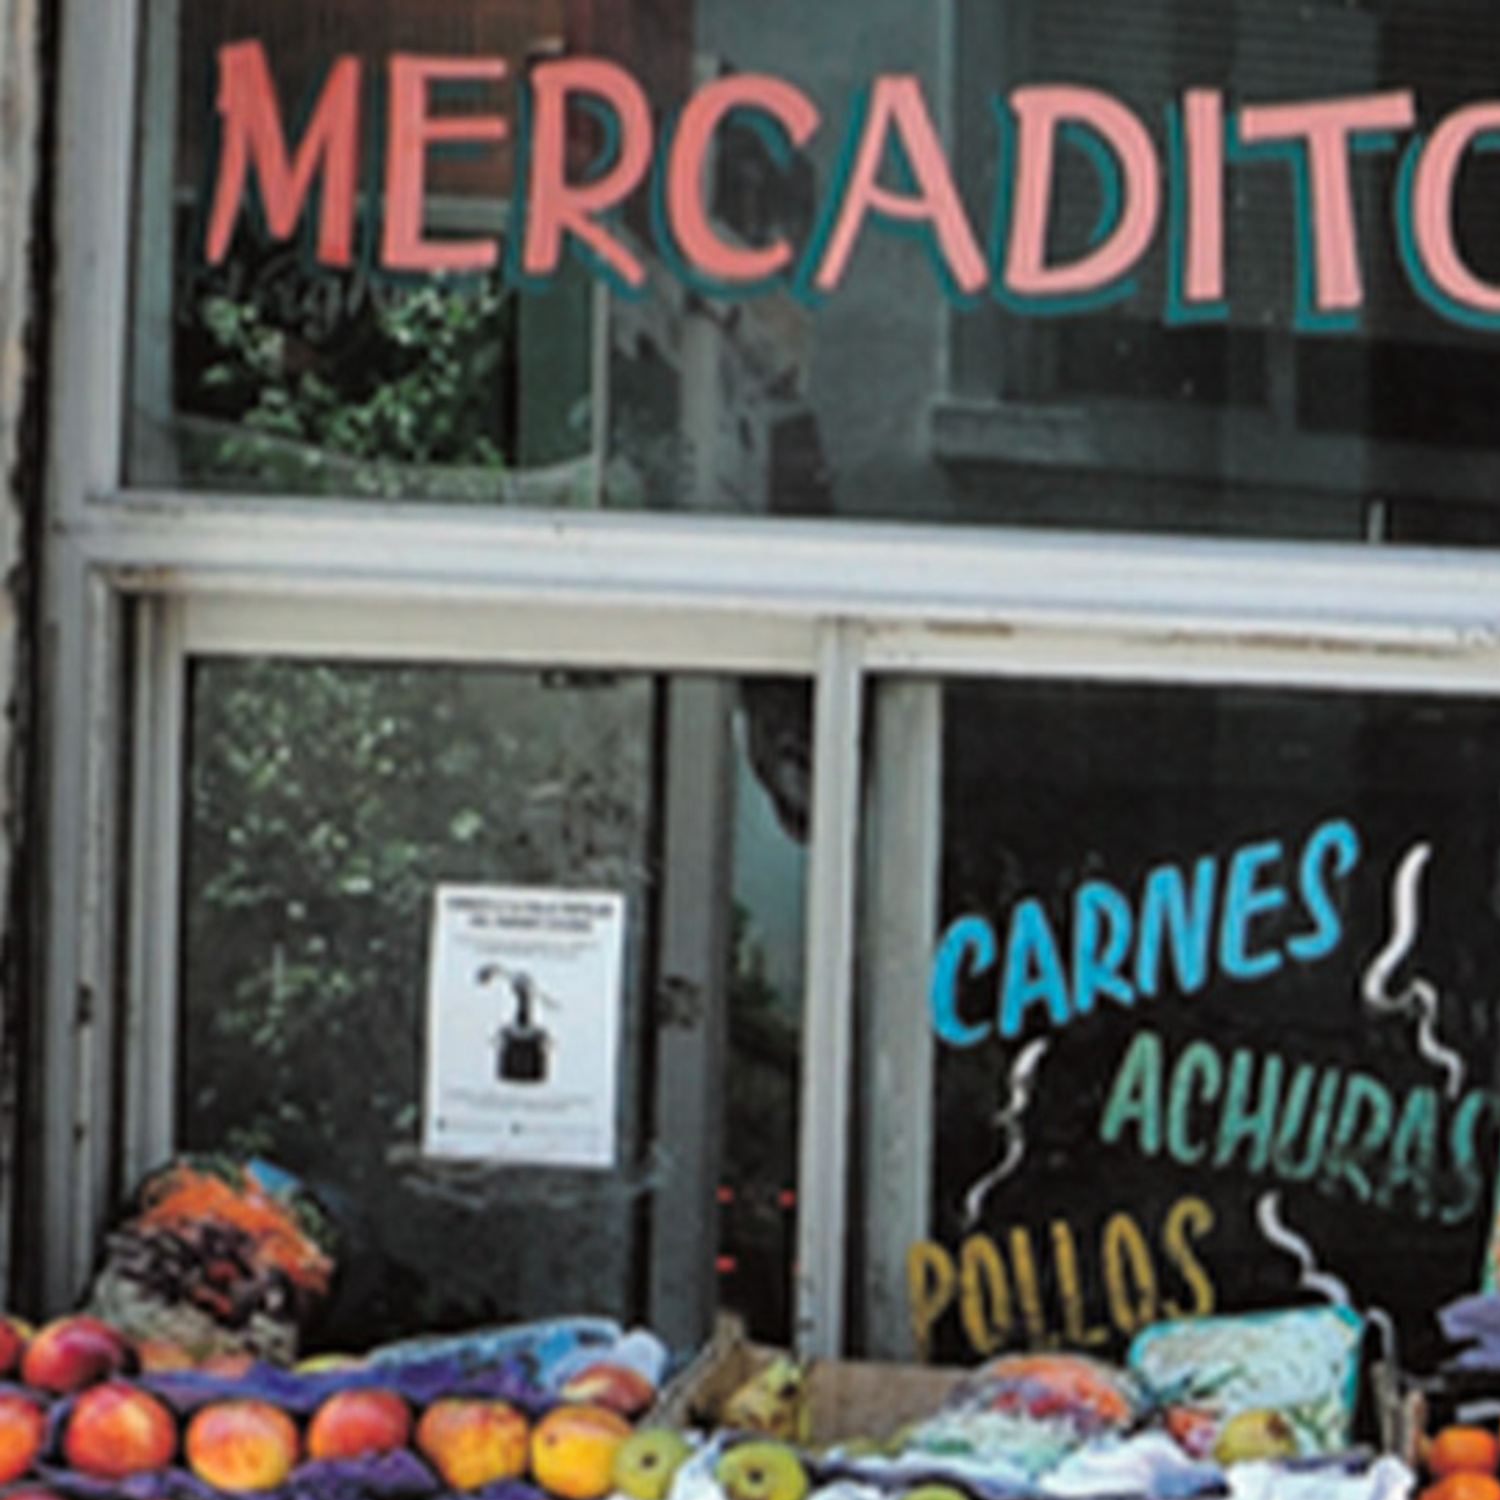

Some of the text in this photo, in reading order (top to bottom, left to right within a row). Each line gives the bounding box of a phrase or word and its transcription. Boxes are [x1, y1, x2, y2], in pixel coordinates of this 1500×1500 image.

[929, 818, 1362, 1045] CARNES
[1100, 1030, 1492, 1225] ACHURAS
[904, 1196, 1217, 1364] POLLOS
